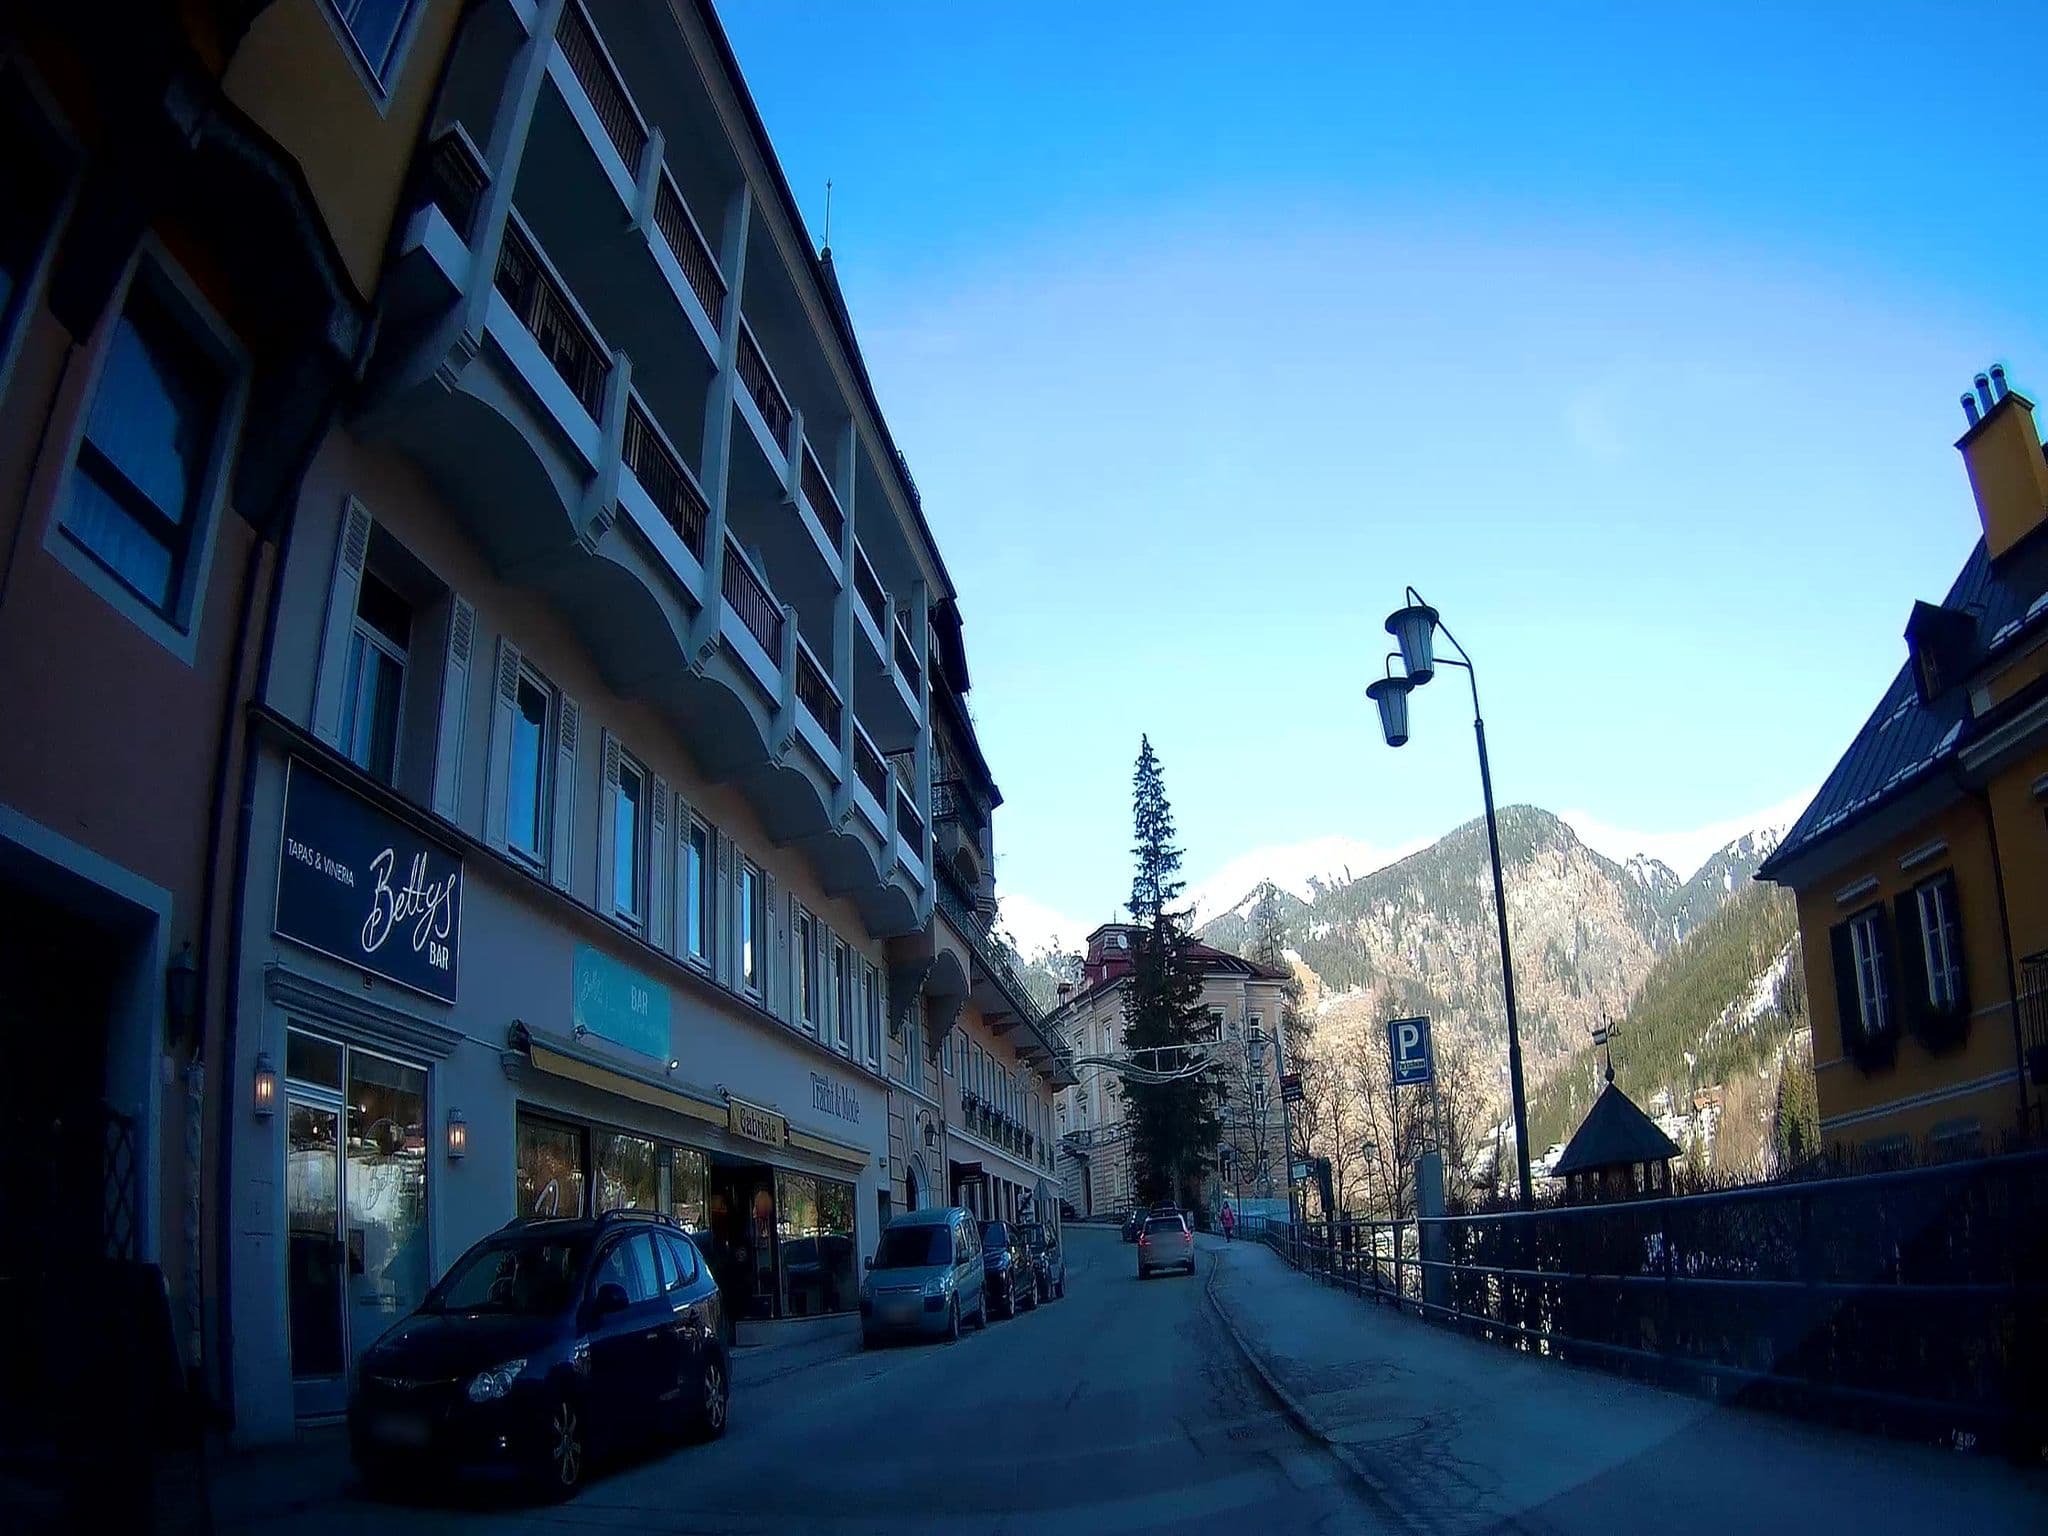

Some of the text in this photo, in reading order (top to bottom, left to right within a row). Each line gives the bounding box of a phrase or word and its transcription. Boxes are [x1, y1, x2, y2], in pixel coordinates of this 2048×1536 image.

[288, 839, 355, 888] TAPAS & VINERIA
[361, 847, 457, 953] Bettys
[430, 941, 449, 970] BAR
[631, 985, 649, 1016] BAR
[1398, 1023, 1419, 1060] P
[740, 1107, 777, 1142] Gabriela
